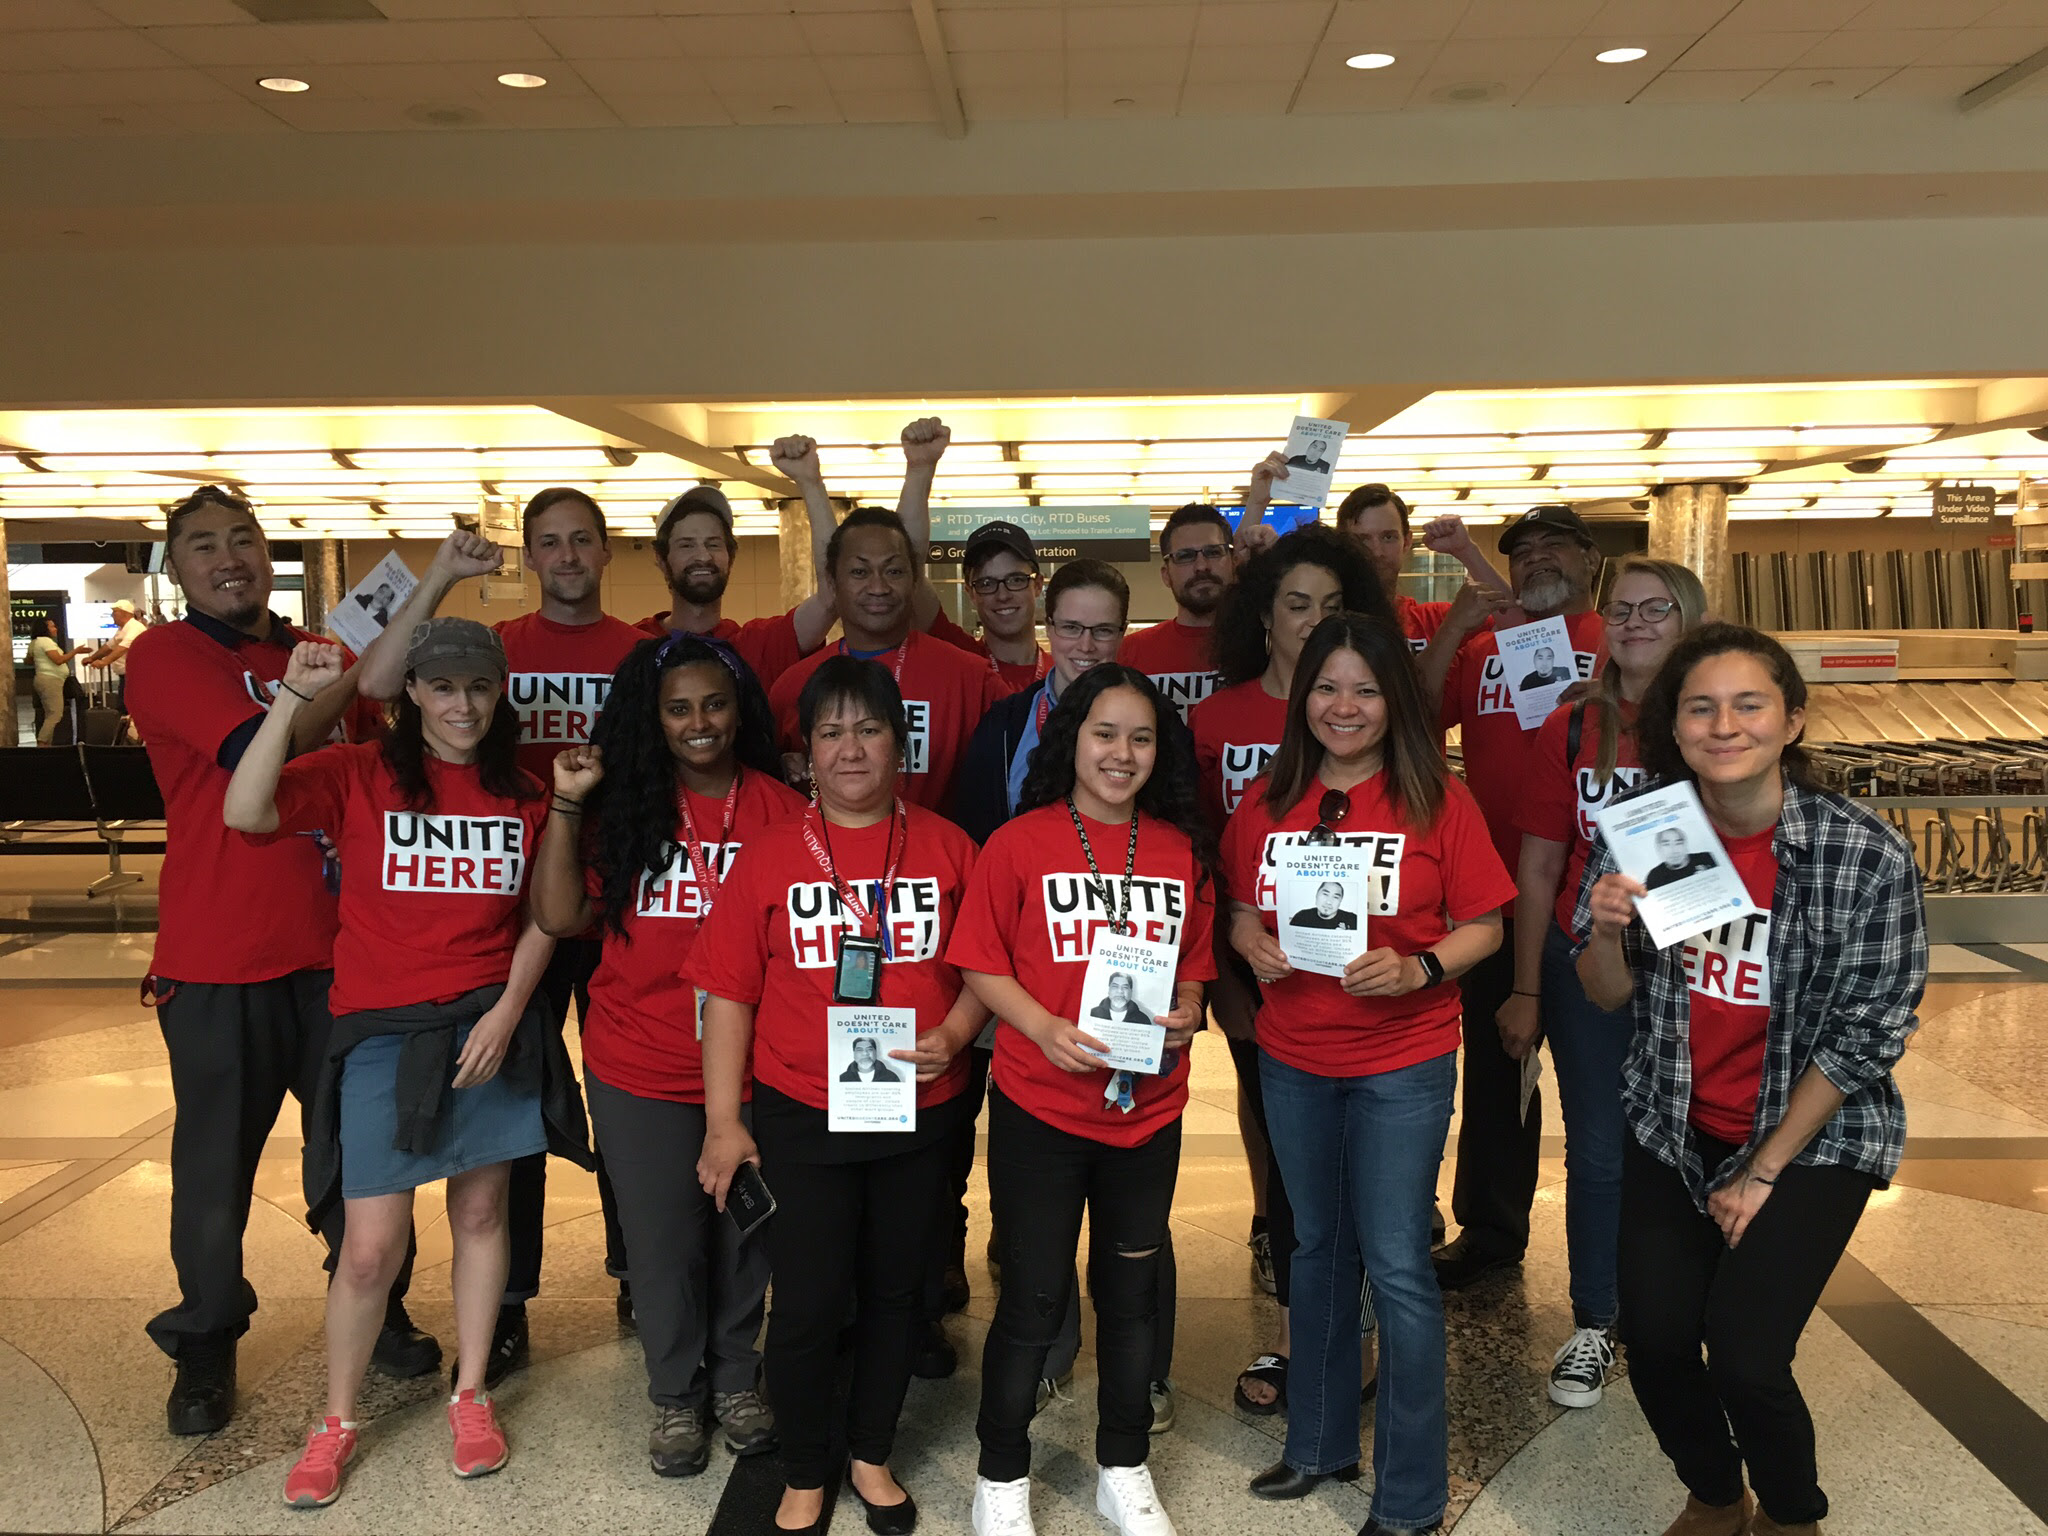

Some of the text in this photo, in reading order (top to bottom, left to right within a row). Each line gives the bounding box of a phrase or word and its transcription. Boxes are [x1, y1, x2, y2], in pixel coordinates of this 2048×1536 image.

[1946, 493, 1986, 502] This Area
[1937, 504, 1991, 513] Under Video
[947, 514, 973, 525] RTD
[1006, 514, 1019, 524] to
[1021, 513, 1046, 526] City,
[1049, 513, 1074, 523] RTD
[1077, 513, 1111, 523] Buses
[1940, 515, 1990, 524] Surveillance
[947, 547, 966, 558] Gro
[1035, 546, 1076, 557] rtation
[1505, 628, 1562, 647] DOESN'T CARE
[1517, 626, 1547, 638] UNITED
[1514, 640, 1541, 651] ABOUT
[512, 676, 611, 705] UNIT
[516, 710, 604, 740] HER
[389, 815, 521, 854] UNITE
[681, 810, 691, 829] UNITE
[691, 845, 709, 884] EQUALITY
[702, 886, 711, 900] UNIT
[1265, 835, 1400, 869] UTE
[1303, 854, 1343, 862] UNITED
[386, 852, 520, 893] HERE!
[1286, 861, 1361, 871] DOESN'T CARE
[1295, 869, 1350, 878] ABOUT US.
[791, 882, 936, 919] UNITE
[844, 892, 866, 919] UNITE
[1047, 876, 1183, 919] UNITE
[794, 919, 934, 964] HEE!
[1099, 948, 1169, 968] DOESN'T CARE
[1116, 944, 1153, 957] UNITED
[1106, 958, 1158, 974] ABOUT US.
[1683, 945, 1763, 1000] ERE
